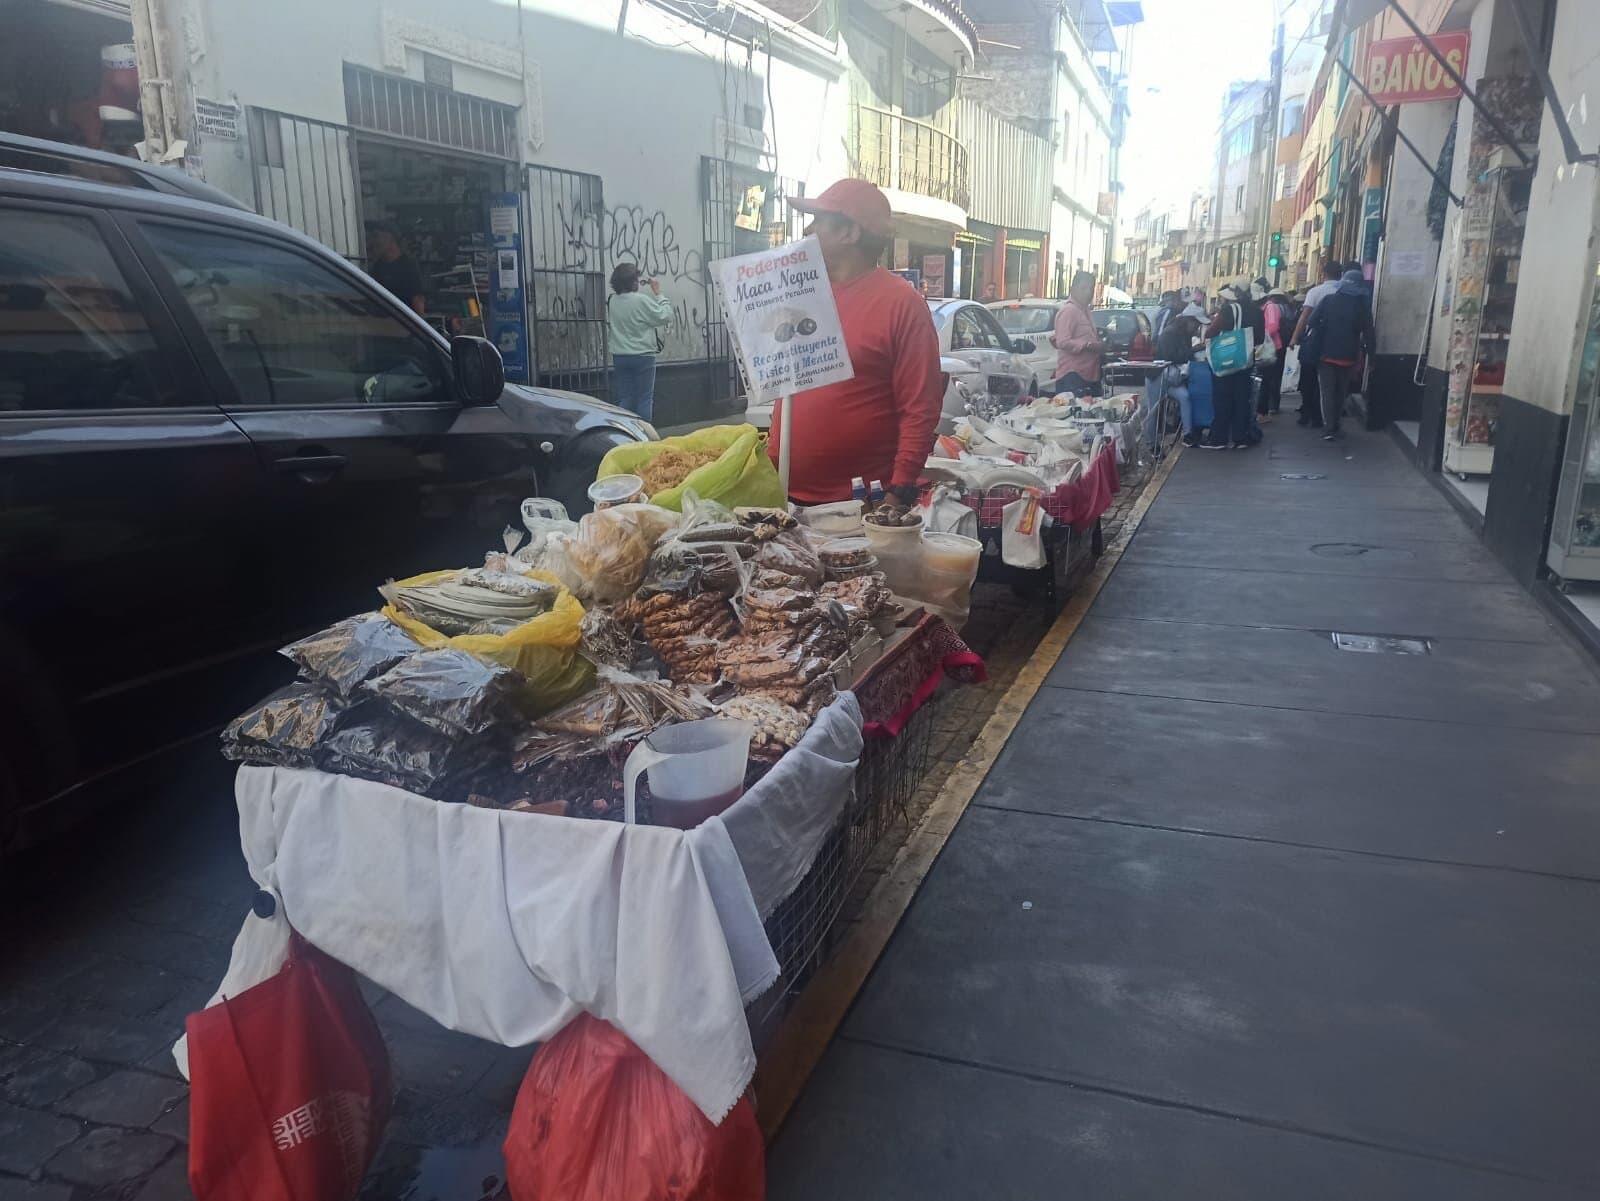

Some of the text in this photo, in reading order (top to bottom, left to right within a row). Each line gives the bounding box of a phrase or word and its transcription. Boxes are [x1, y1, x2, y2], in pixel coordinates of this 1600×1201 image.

[1368, 43, 1462, 94] BAÑOS
[736, 251, 808, 282] Poderosa
[733, 268, 819, 303] Maca Negra
[753, 336, 838, 368] Reconstituyente
[793, 361, 800, 373] y
[802, 348, 838, 369] Mental
